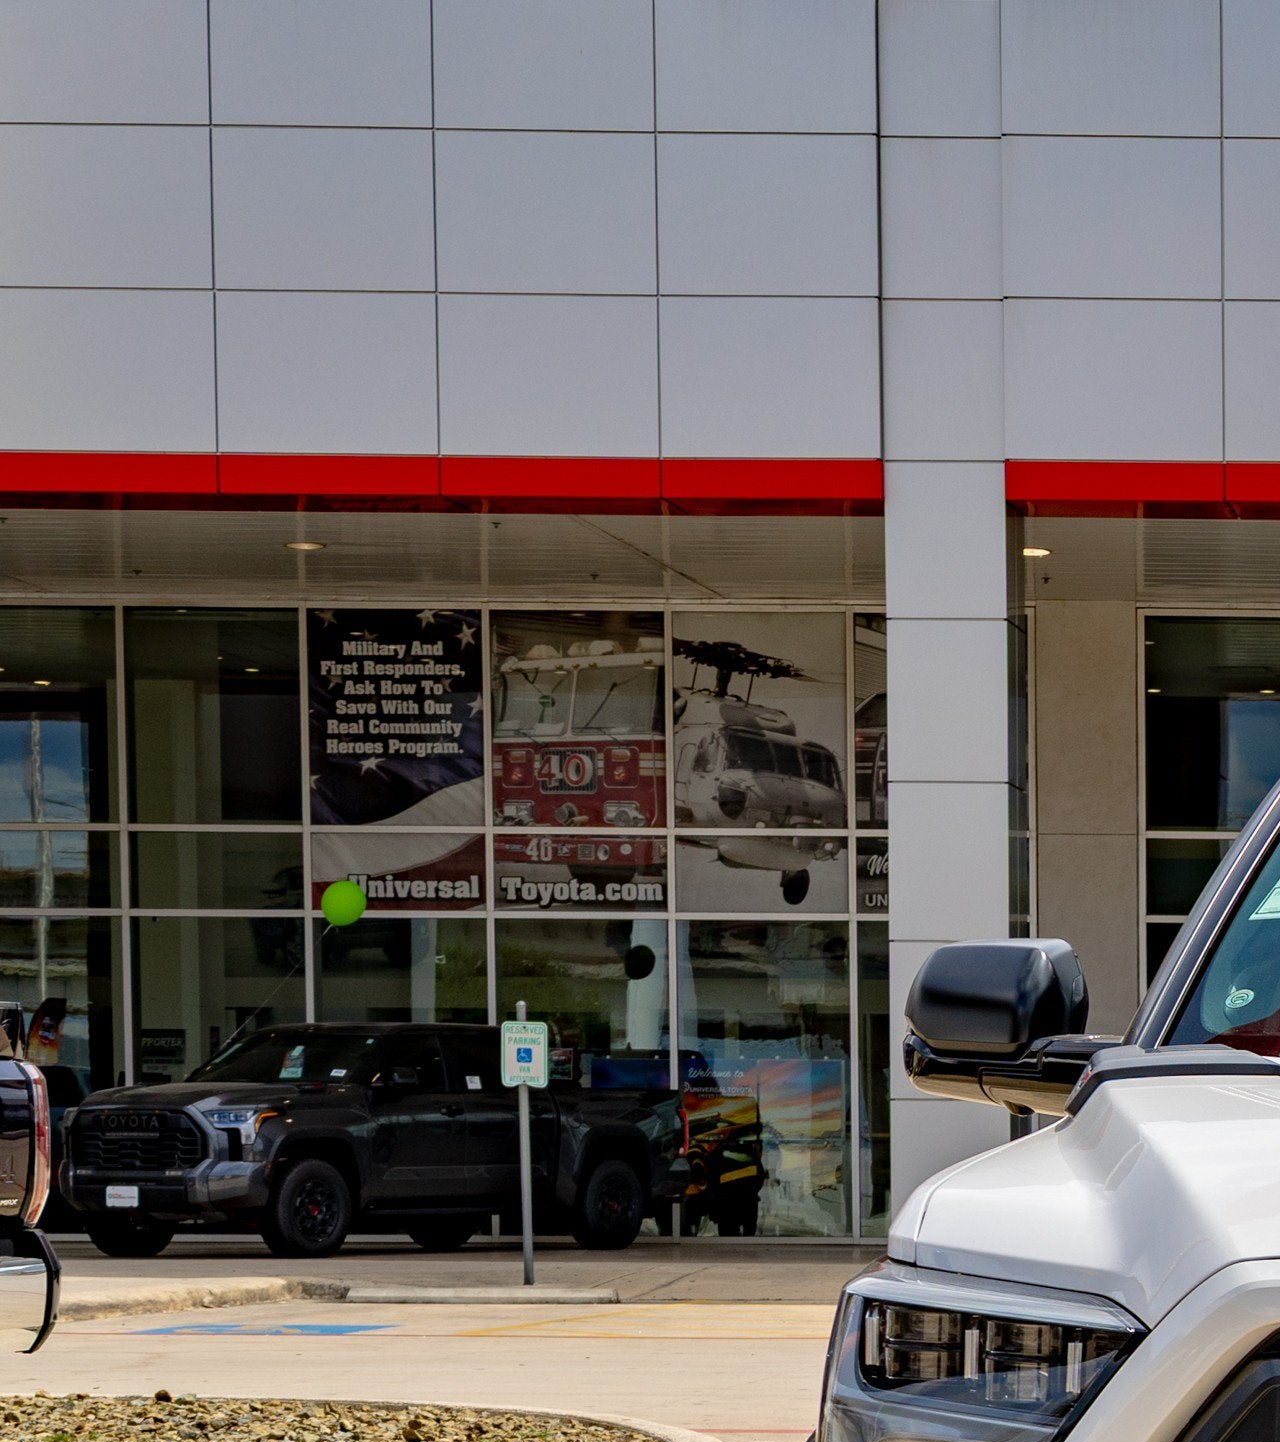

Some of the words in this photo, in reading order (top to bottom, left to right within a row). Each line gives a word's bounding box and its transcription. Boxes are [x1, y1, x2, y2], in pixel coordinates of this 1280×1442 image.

[342, 640, 406, 659] Military
[411, 640, 443, 656] And
[320, 660, 359, 676] First
[363, 660, 466, 679] Responders,
[344, 680, 376, 695] Ask
[380, 680, 417, 695] How
[421, 680, 443, 695] To
[335, 700, 377, 715] Save
[381, 699, 419, 715] With
[424, 700, 453, 715] Our
[326, 719, 364, 734] Real
[368, 719, 463, 738] Community
[326, 738, 384, 754] Heroes
[388, 738, 464, 758] Program.
[536, 754, 593, 787] 40
[501, 875, 664, 906] Toyota.com
[505, 1025, 544, 1035] RESERVED
[507, 1036, 541, 1046] PARKING
[100, 1115, 159, 1128] TOYOTA
